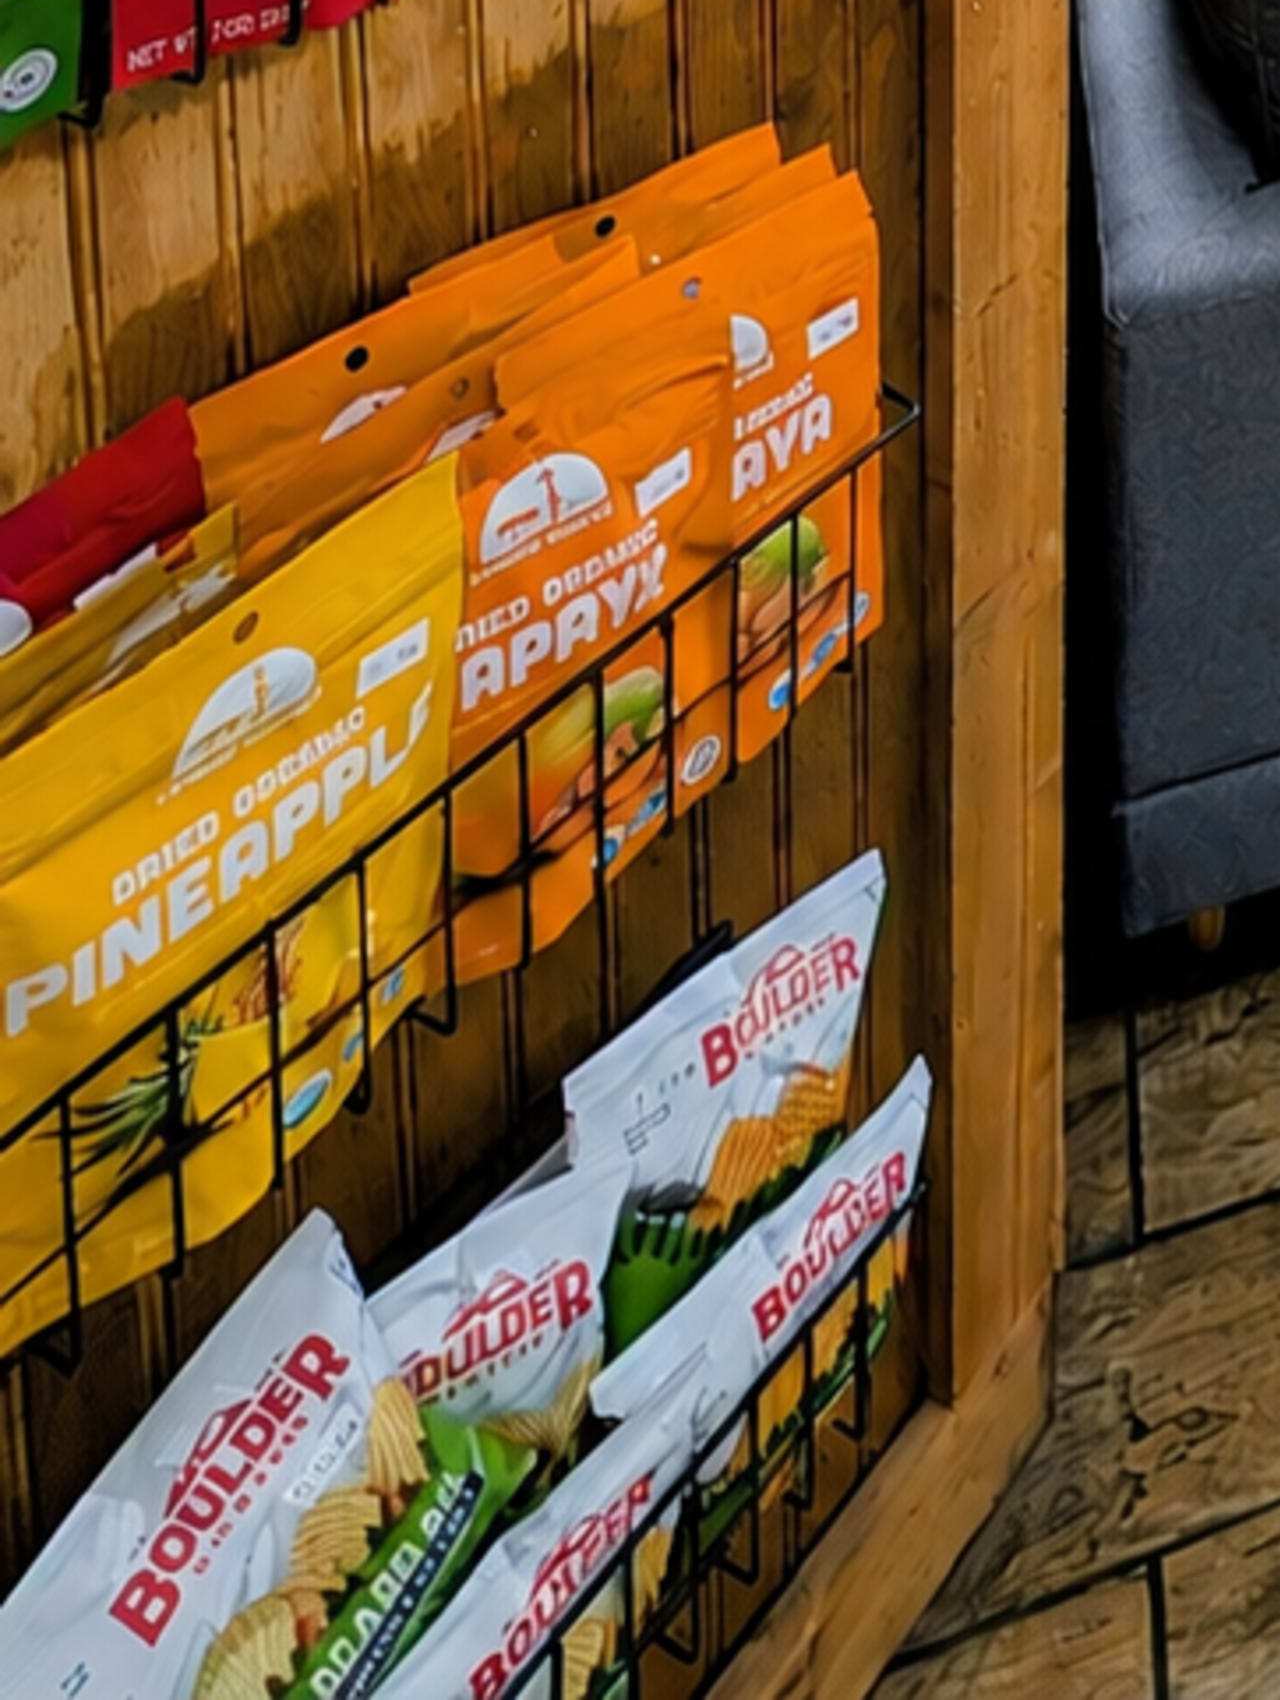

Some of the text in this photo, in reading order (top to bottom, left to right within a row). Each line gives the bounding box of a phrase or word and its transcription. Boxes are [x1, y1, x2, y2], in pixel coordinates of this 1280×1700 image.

[700, 935, 860, 1090] BOULDER
[401, 1259, 595, 1398] OULDER
[109, 1333, 350, 1648] BOULDER
